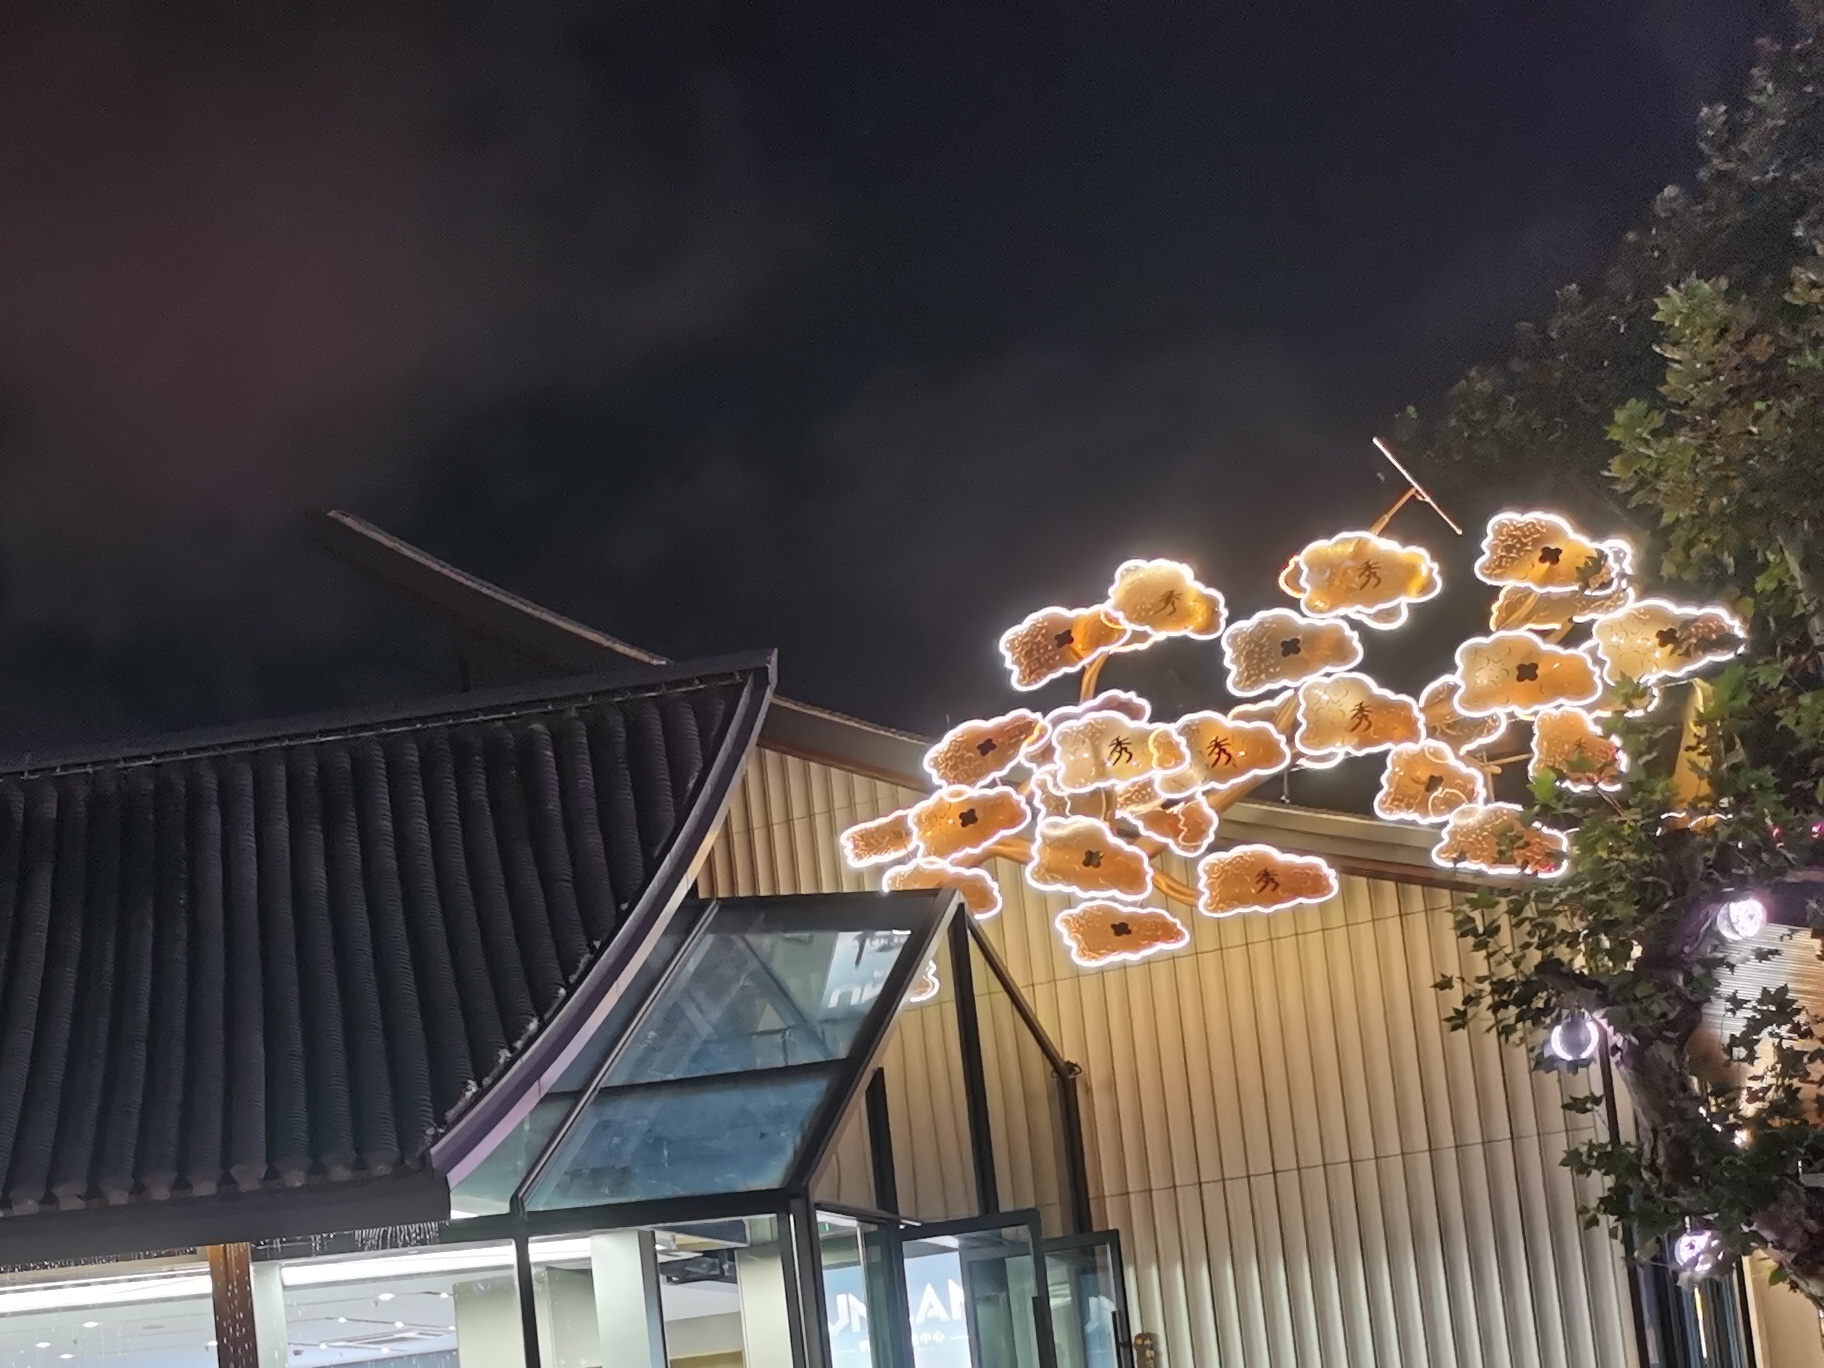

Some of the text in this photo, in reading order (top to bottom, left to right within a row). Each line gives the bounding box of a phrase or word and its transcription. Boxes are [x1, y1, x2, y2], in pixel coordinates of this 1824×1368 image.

[1358, 559, 1383, 590] 秀
[1154, 589, 1182, 616] 秀
[1350, 701, 1374, 732] 秀
[1108, 735, 1133, 766] 秀
[1206, 736, 1233, 768] 秀
[1255, 868, 1279, 893] 秀
